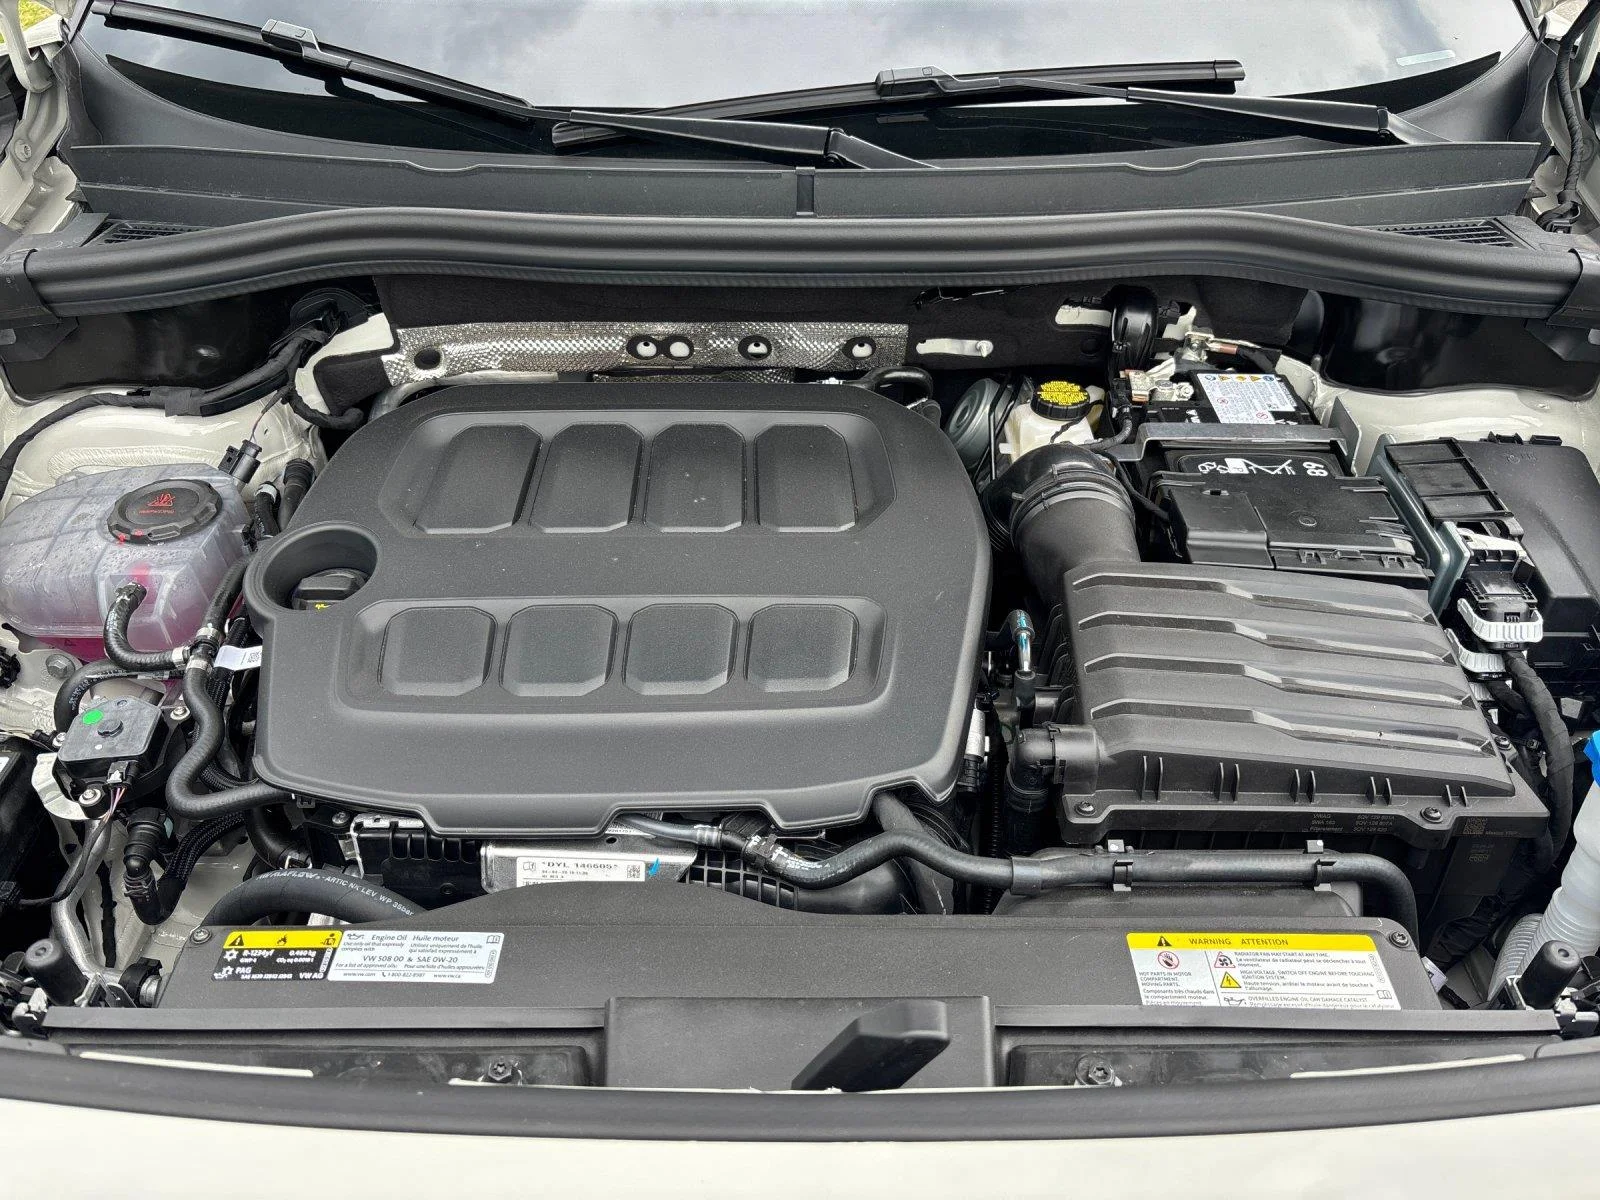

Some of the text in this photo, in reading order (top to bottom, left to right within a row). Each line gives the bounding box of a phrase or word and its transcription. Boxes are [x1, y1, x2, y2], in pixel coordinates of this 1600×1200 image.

[361, 888, 378, 897] LEV
[379, 894, 392, 904] WP
[392, 901, 415, 916] 35bar
[371, 934, 396, 942] Engine
[1240, 938, 1289, 946] ATTENTION
[236, 966, 252, 974] PAG
[300, 972, 324, 980] VW AG
